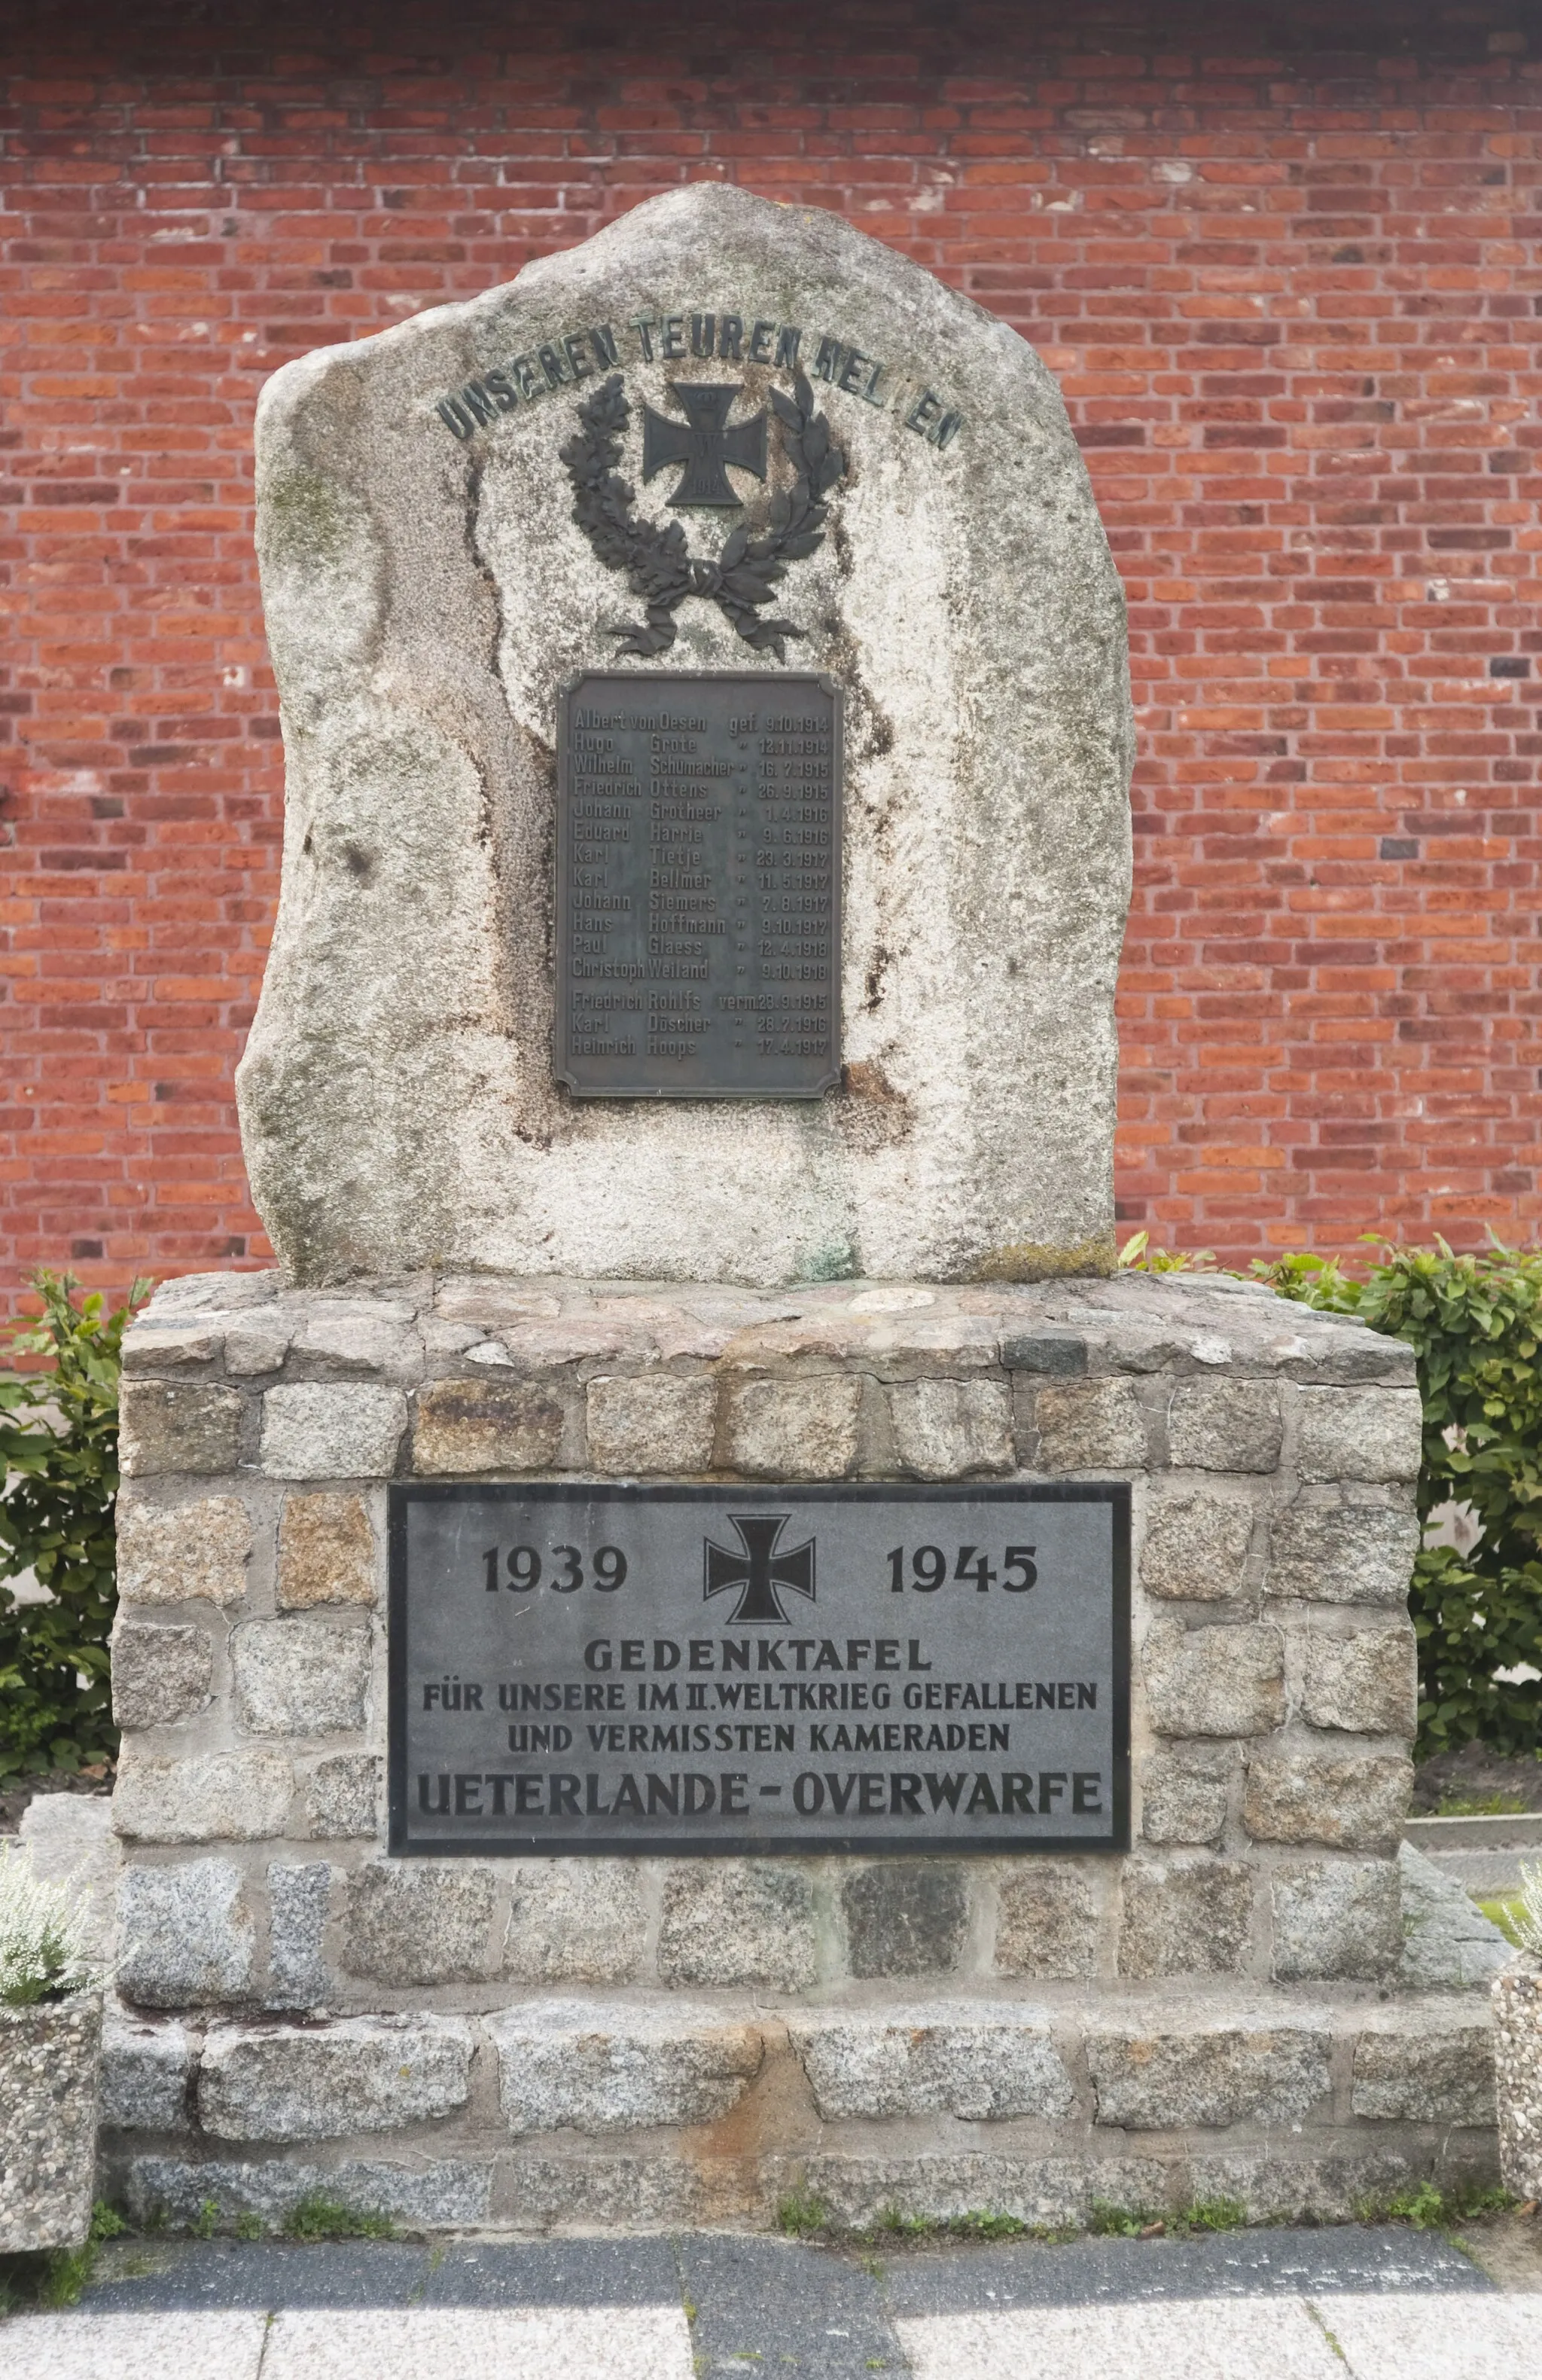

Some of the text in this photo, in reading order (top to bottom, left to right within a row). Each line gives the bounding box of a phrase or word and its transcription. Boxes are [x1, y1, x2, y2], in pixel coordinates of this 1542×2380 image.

[435, 322, 620, 441] UNSEREN
[629, 314, 802, 369] TEUREN
[574, 709, 626, 731] Albert
[630, 716, 656, 731] von
[660, 711, 706, 731] Oesen
[574, 732, 614, 754] Hugo
[651, 734, 697, 752] Grote
[574, 755, 634, 774] Wilhelm
[651, 755, 735, 777] Schumacher
[574, 777, 642, 796] Friedrich
[651, 778, 707, 798] Ottens
[573, 798, 631, 818] Johann
[651, 801, 722, 820] Grotheer
[574, 819, 630, 841] Eduard
[651, 822, 702, 842] Harrie
[574, 843, 608, 864] Karl
[650, 844, 701, 872] Tietje
[573, 866, 608, 887] Karl
[650, 868, 712, 889] Bellmer
[573, 890, 631, 910] Johann
[650, 891, 717, 911] Siemers
[573, 912, 613, 931] Hans
[649, 913, 726, 934] Hoffmann
[572, 934, 608, 954] Paul
[648, 935, 702, 955] Glaess
[572, 957, 645, 984] Christoph
[648, 958, 709, 979] Weiland
[572, 990, 642, 1011] Friedrich
[648, 990, 702, 1010] Rohlfs
[572, 1012, 608, 1033] Karl
[648, 1012, 711, 1033] Döscher
[572, 1035, 636, 1055] Heinrich
[648, 1036, 696, 1061] Hoops
[483, 1545, 1038, 1593] 1939 1945
[584, 1638, 933, 1672] GEDENKTAFEL
[422, 1676, 484, 1712] FÜR
[498, 1683, 626, 1712] UNSERE
[637, 1683, 679, 1711] IM
[904, 1682, 1098, 1711] GEFALLENEN
[507, 1724, 1010, 1753] UND VERMISSTEN KAMERADEN
